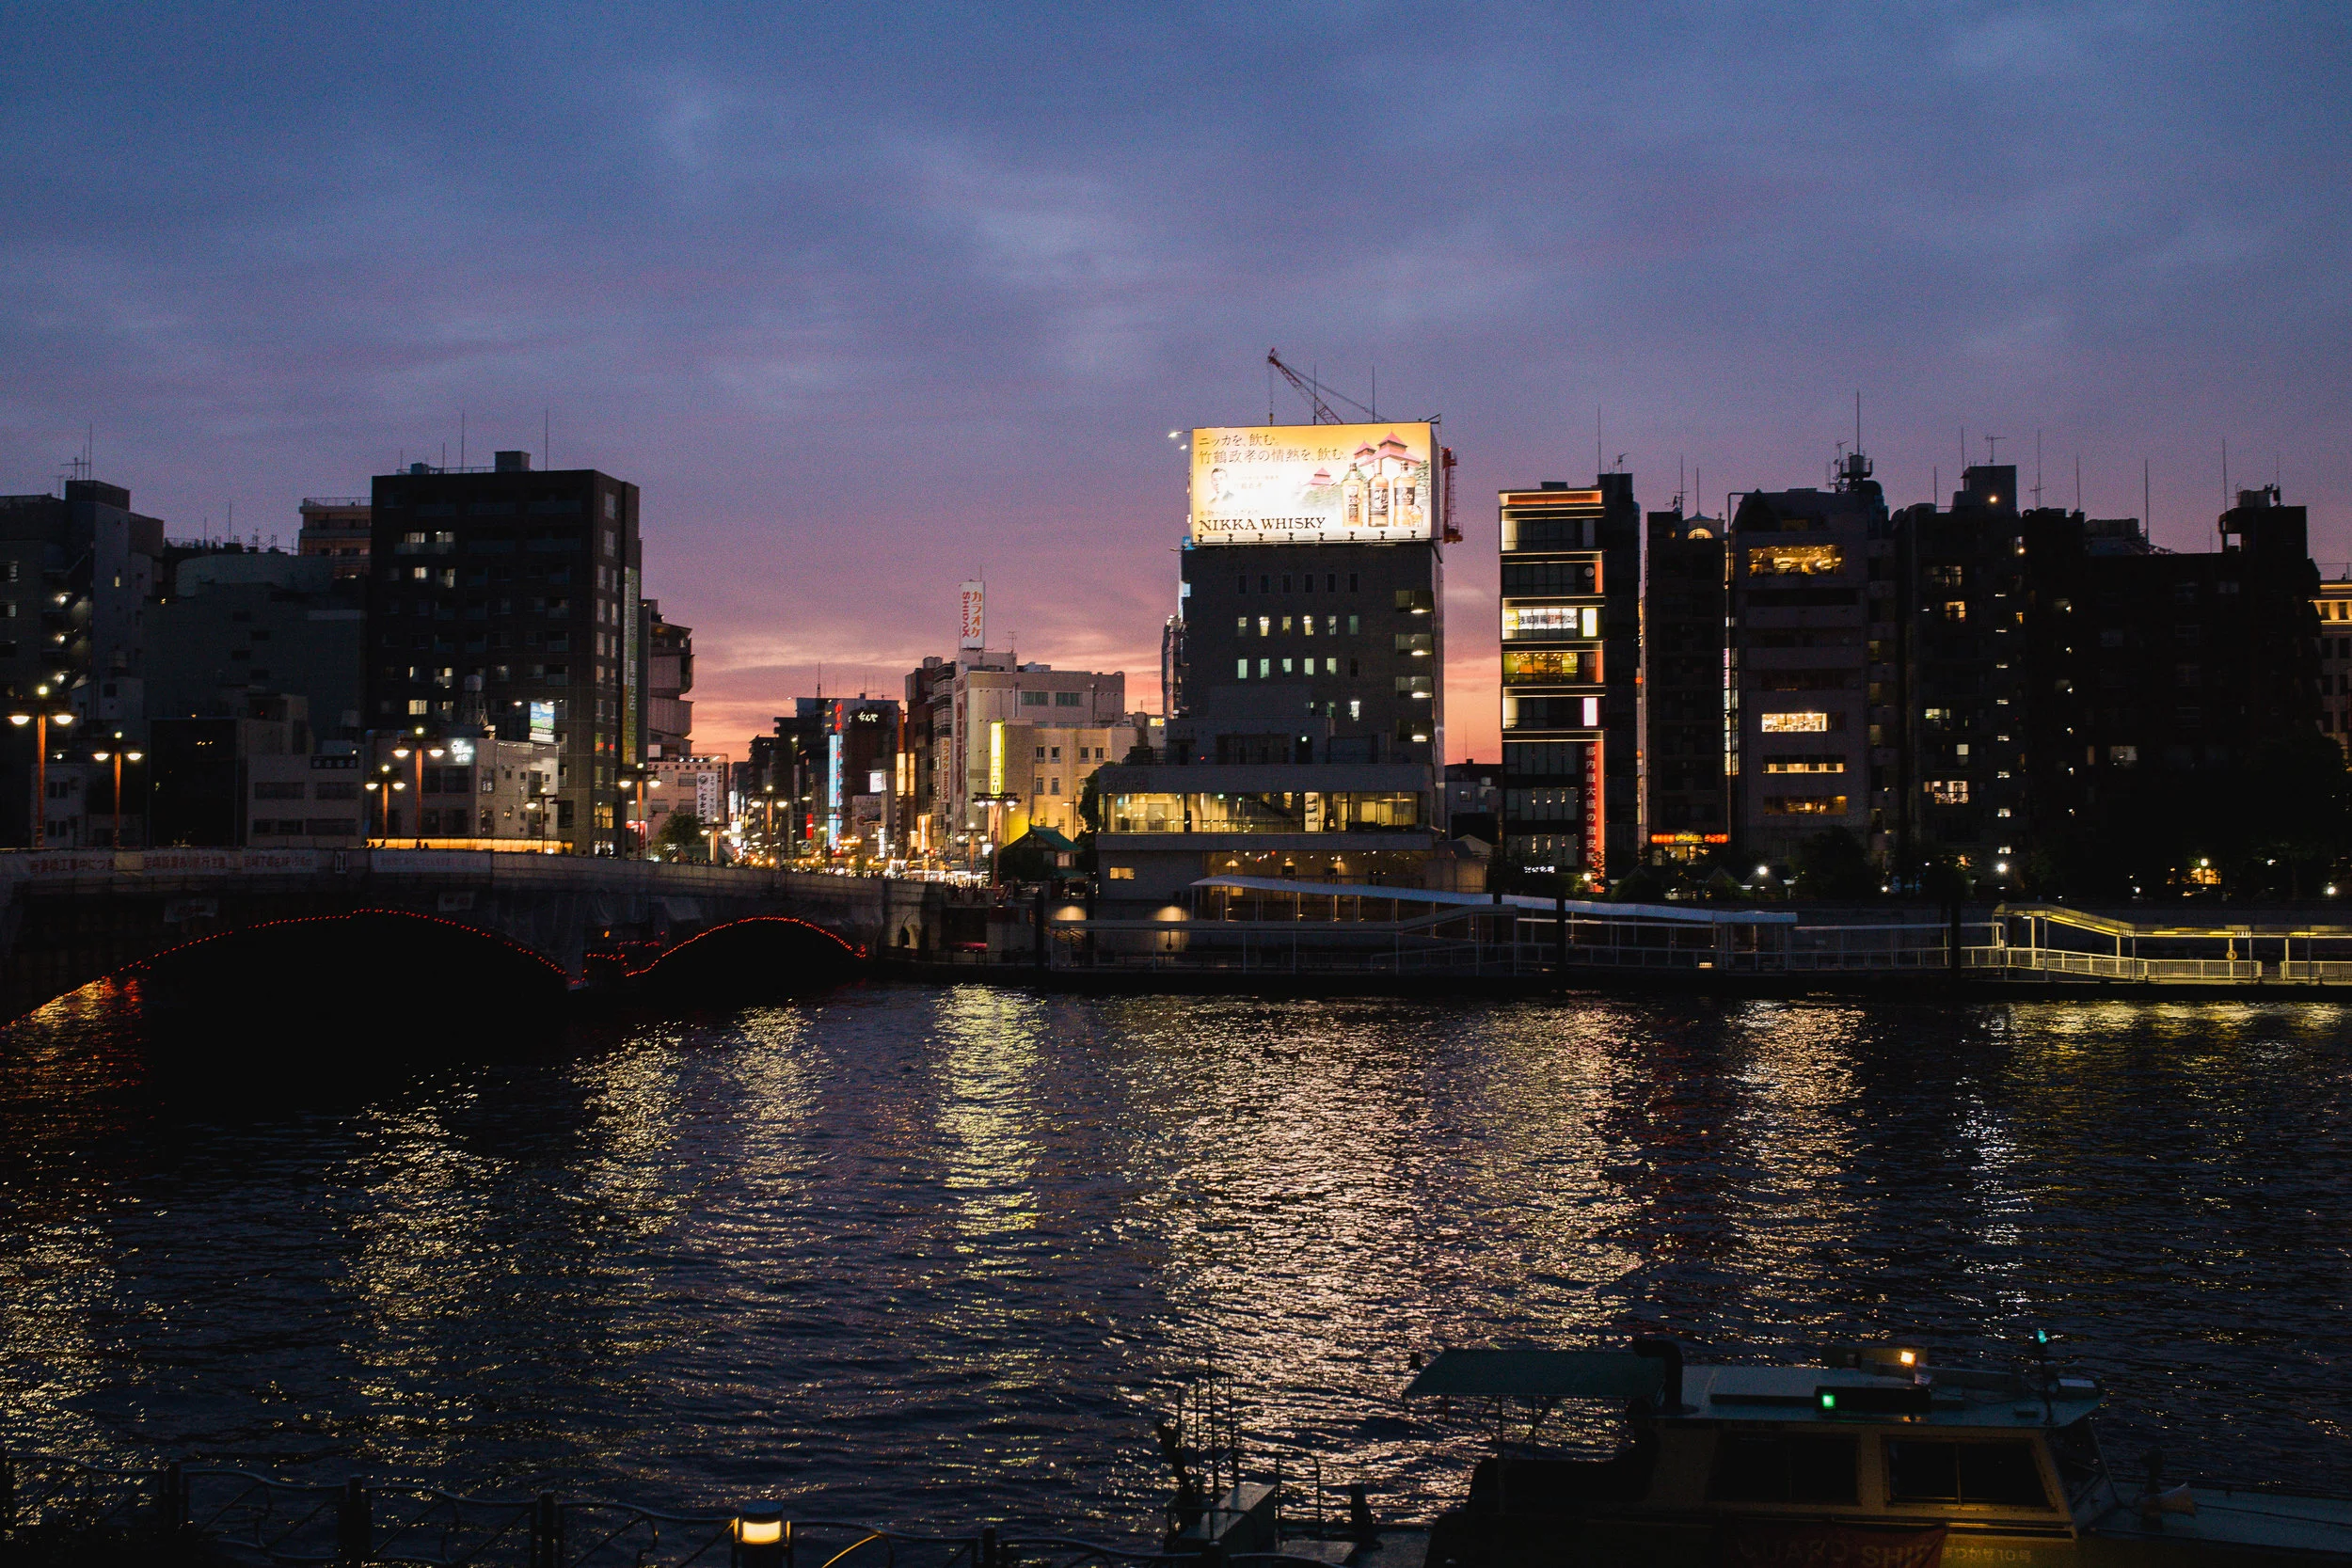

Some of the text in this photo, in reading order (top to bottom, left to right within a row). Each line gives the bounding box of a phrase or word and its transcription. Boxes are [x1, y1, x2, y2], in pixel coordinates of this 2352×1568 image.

[1198, 516, 1327, 531] NIKKA WHISKY
[971, 591, 983, 639] カラオケ
